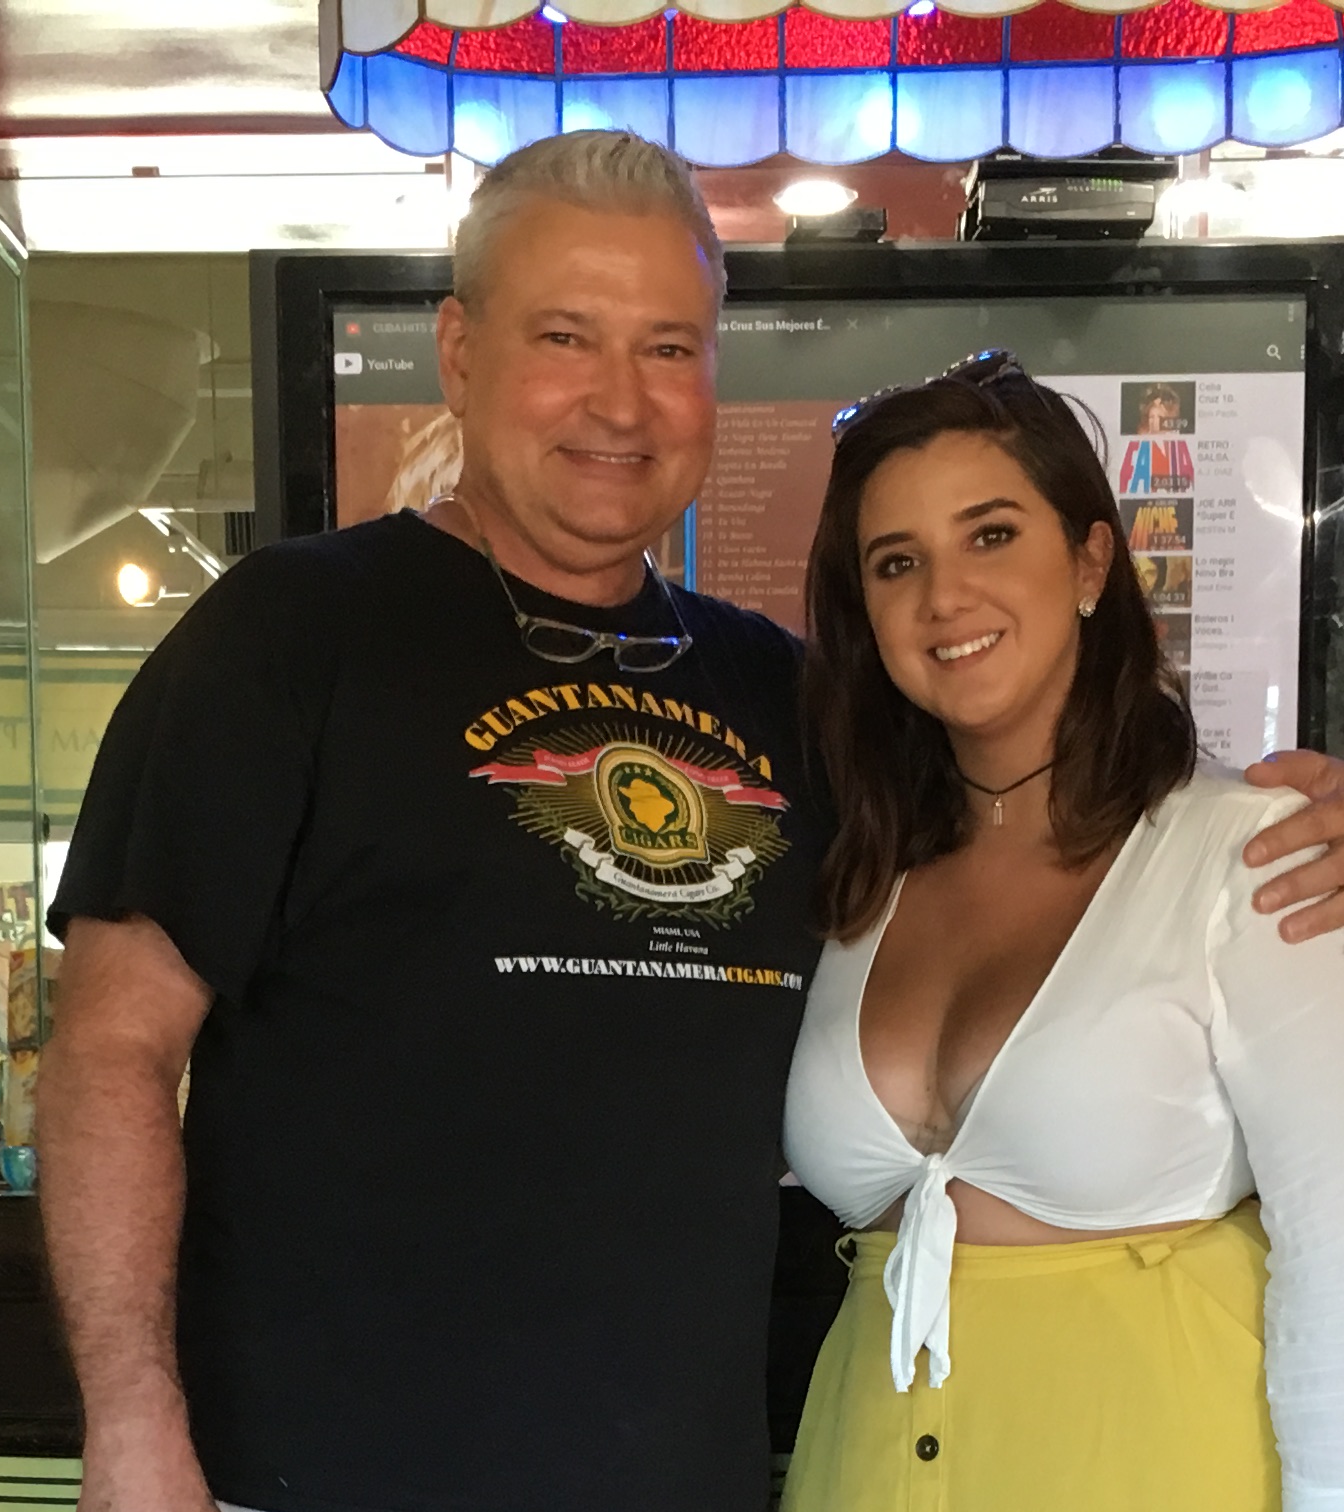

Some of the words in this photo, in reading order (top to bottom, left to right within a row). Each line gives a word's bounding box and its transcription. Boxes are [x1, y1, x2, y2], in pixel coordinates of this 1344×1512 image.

[1020, 195, 1058, 203] ARRIS
[730, 320, 753, 331] Cruz
[755, 320, 774, 331] Sus
[776, 319, 815, 333] Mejores
[367, 358, 414, 371] YouTube
[1197, 441, 1229, 450] RETRO
[1119, 440, 1195, 494] FANIA
[464, 682, 773, 781] GUANTANAMERA
[621, 828, 699, 849] CIGARS
[684, 929, 702, 939] USA
[649, 940, 673, 952] Little
[675, 941, 709, 955] Havana
[494, 956, 803, 991] WWW.GUANTANAMERACIGARS.COM
